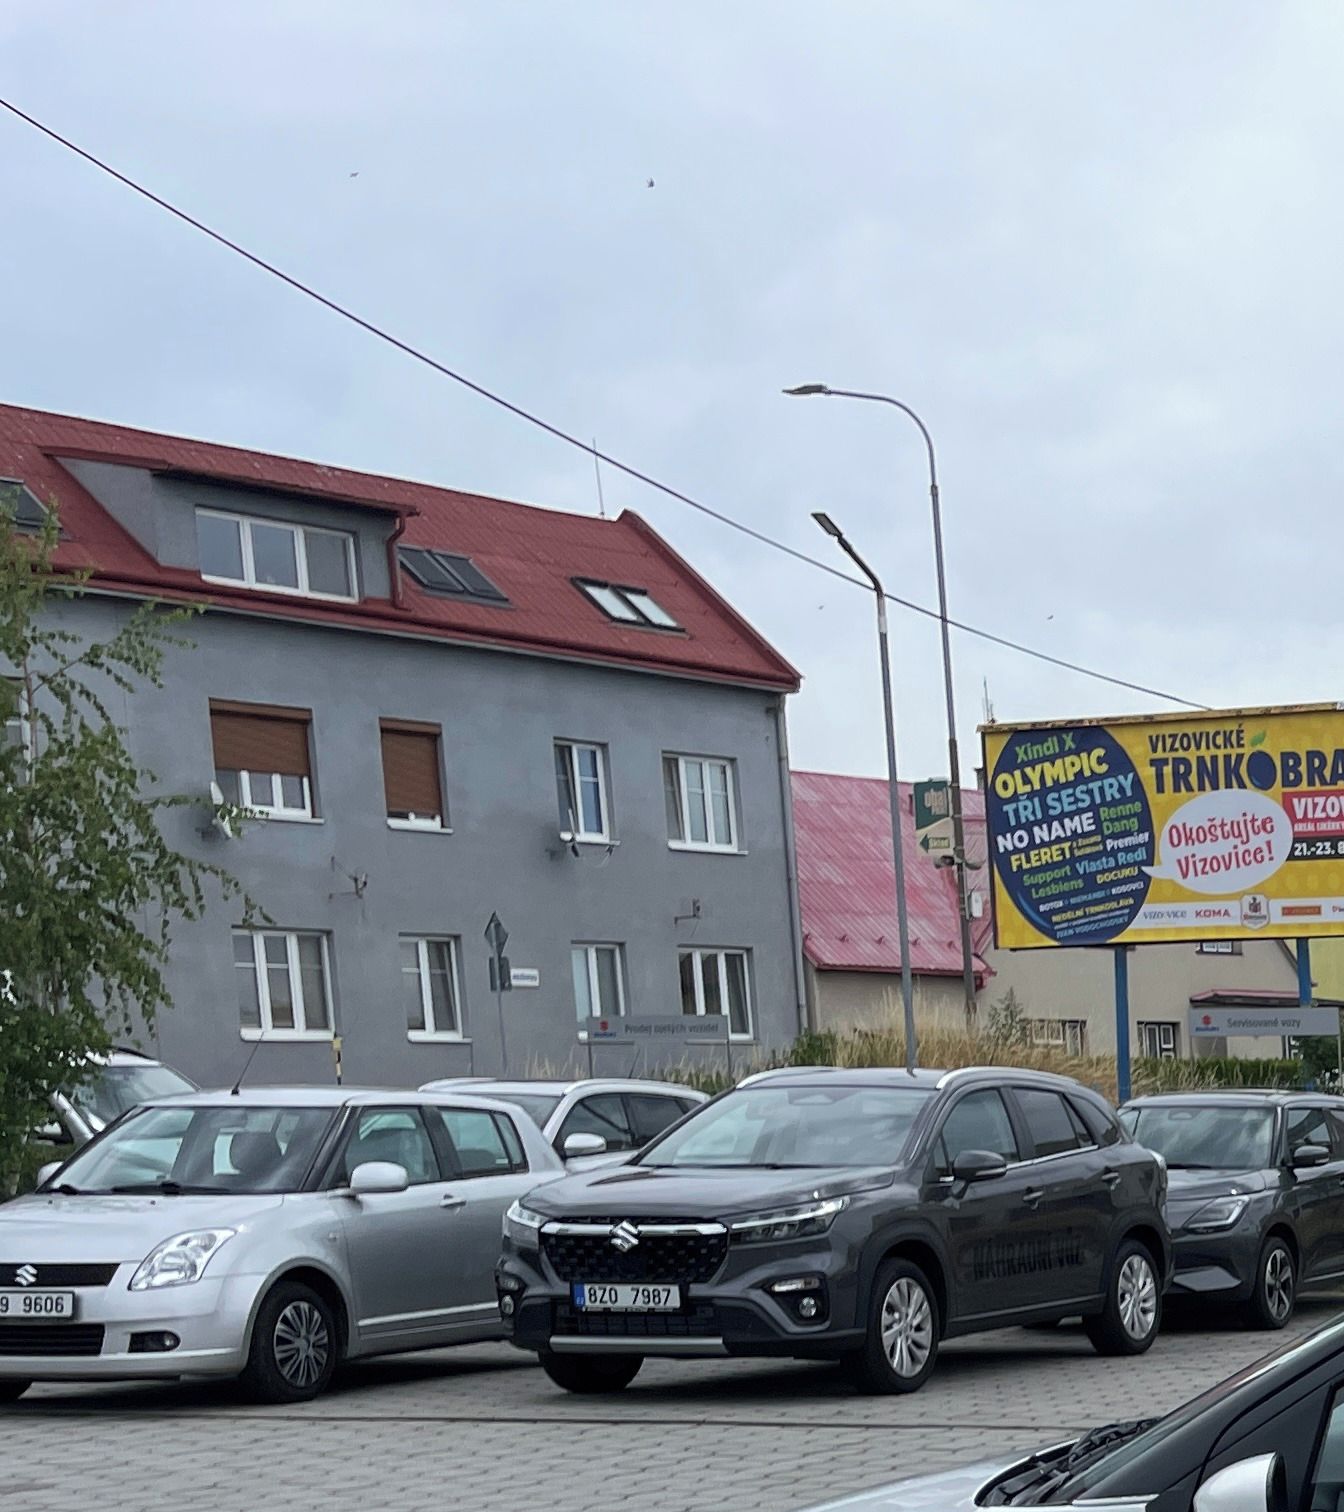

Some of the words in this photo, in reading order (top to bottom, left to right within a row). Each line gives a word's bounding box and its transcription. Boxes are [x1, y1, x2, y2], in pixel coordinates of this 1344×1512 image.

[1015, 737, 1059, 763] Xindl
[1062, 732, 1076, 751] X
[1148, 724, 1245, 753] VIZOVICKÉ
[994, 748, 1109, 799] OLYMPIC
[1002, 794, 1043, 827] TŘI
[1045, 772, 1136, 816] SESTRY
[1100, 801, 1142, 821] Renne
[996, 829, 1030, 853] NO
[1033, 812, 1096, 845] NAME
[1102, 817, 1139, 835] Dang
[1168, 811, 1275, 848] Okoštujte
[1105, 831, 1150, 851] Premier
[1010, 842, 1073, 872] FLERET
[1075, 856, 1116, 875] Vlasta
[1117, 847, 1147, 866] Redl
[1176, 840, 1275, 880] Vizovice!
[1023, 865, 1072, 887] Support
[1195, 908, 1231, 919] KOMA
[23, 1296, 64, 1313] 9606
[630, 1287, 671, 1305] 7987
